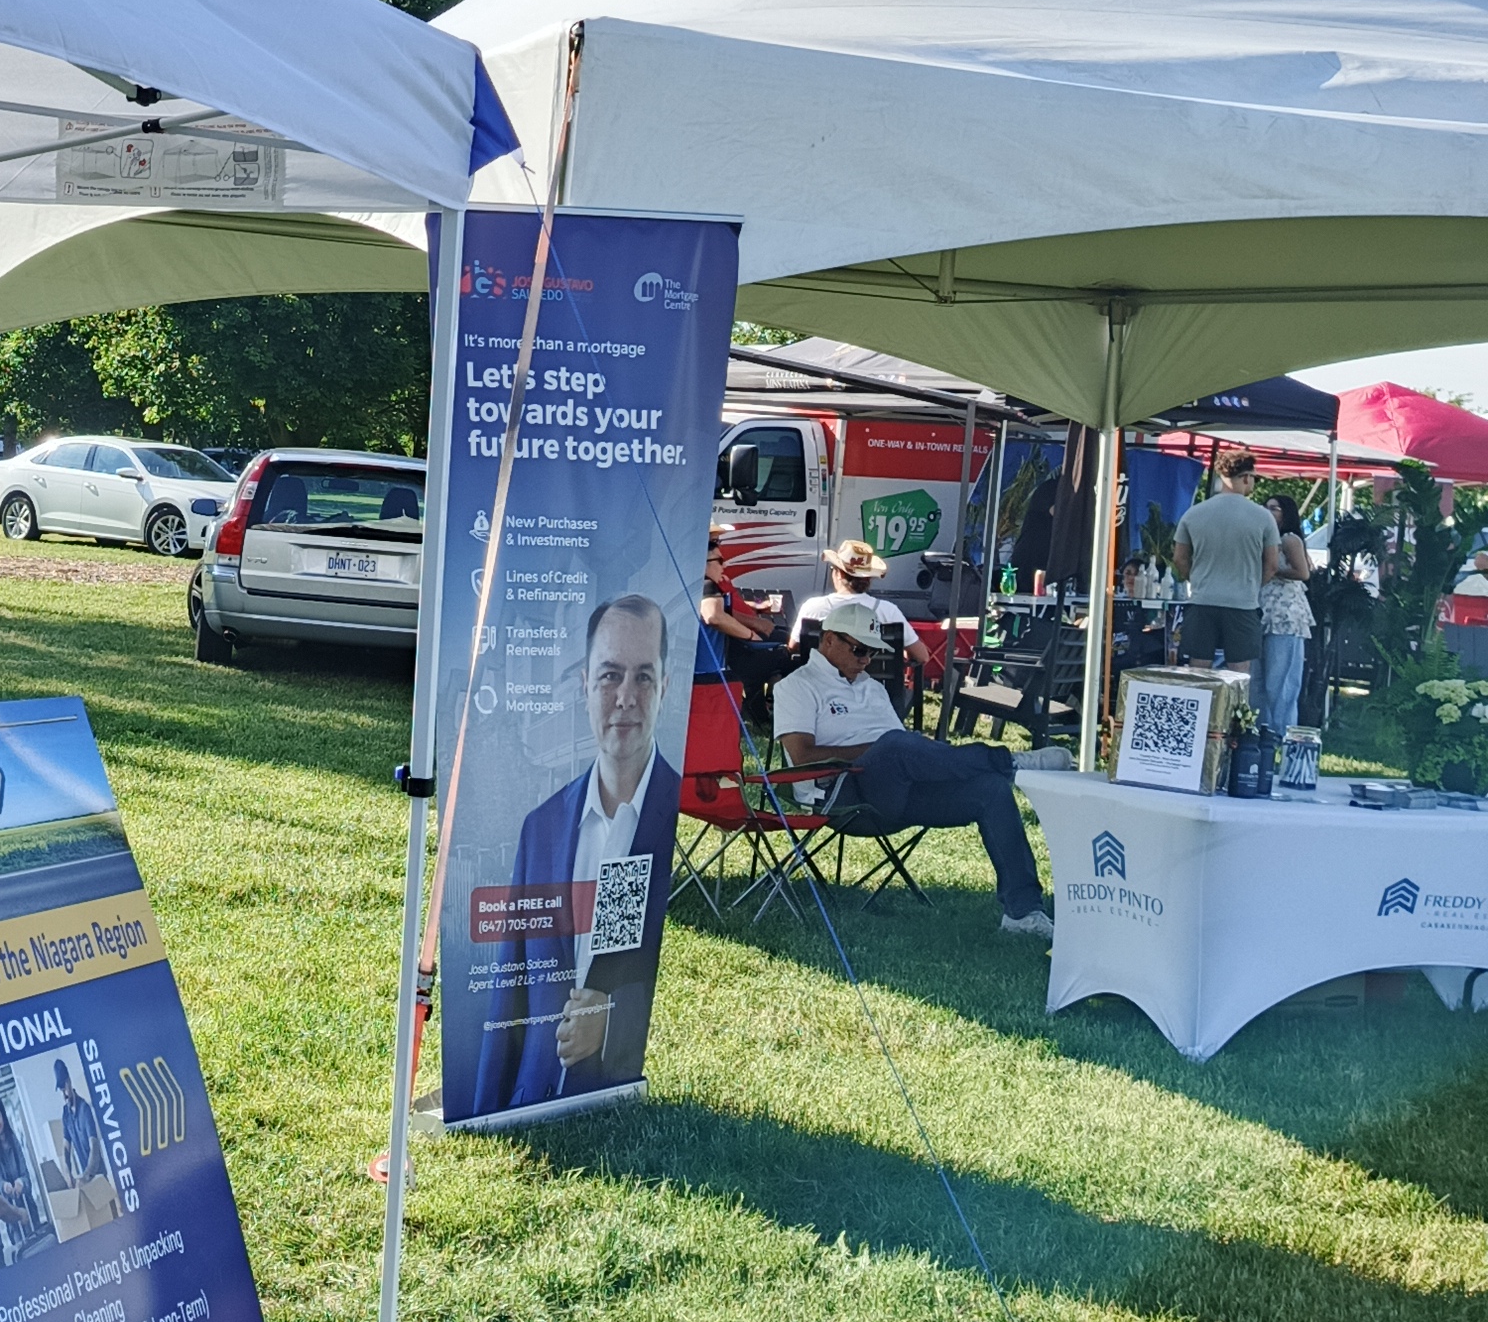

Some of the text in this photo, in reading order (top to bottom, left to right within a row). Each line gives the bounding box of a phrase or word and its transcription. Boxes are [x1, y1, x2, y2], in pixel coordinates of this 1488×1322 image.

[664, 278, 681, 289] The
[511, 288, 563, 301] SALEDO
[464, 333, 485, 348] It's
[488, 337, 524, 350] more
[566, 341, 574, 352] a
[577, 340, 646, 358] mortgage
[466, 361, 606, 399] Let's step
[466, 397, 662, 434] towards your
[467, 429, 687, 469] future together.
[867, 438, 988, 455] ONE-WAY & IN-TOWN REALS
[505, 515, 598, 530] New Purchases
[505, 533, 590, 547] & Investments
[505, 570, 588, 584] Lines of Credit
[505, 588, 586, 604] & Refinancing
[505, 626, 568, 639] Transfers &
[506, 644, 561, 656] Renewals
[506, 682, 552, 694] Reverse
[506, 700, 565, 714] Mortgages
[478, 896, 562, 913] Book a FREE call
[1067, 883, 1163, 916] FREDDY PINTO
[1424, 894, 1487, 910] FREDDY
[478, 919, 506, 934] (647)
[0, 942, 33, 980] the
[29, 932, 95, 974] Niagara
[92, 915, 148, 960] Region
[468, 963, 488, 976] Jose
[489, 961, 525, 973] Gustavo
[467, 979, 494, 993] Agent
[496, 975, 517, 988] Level
[517, 975, 523, 986] 2
[82, 1038, 140, 1213] SERVICES
[73, 1258, 122, 1296] Packing
[120, 1250, 131, 1273] &
[128, 1230, 185, 1271] Unpacking
